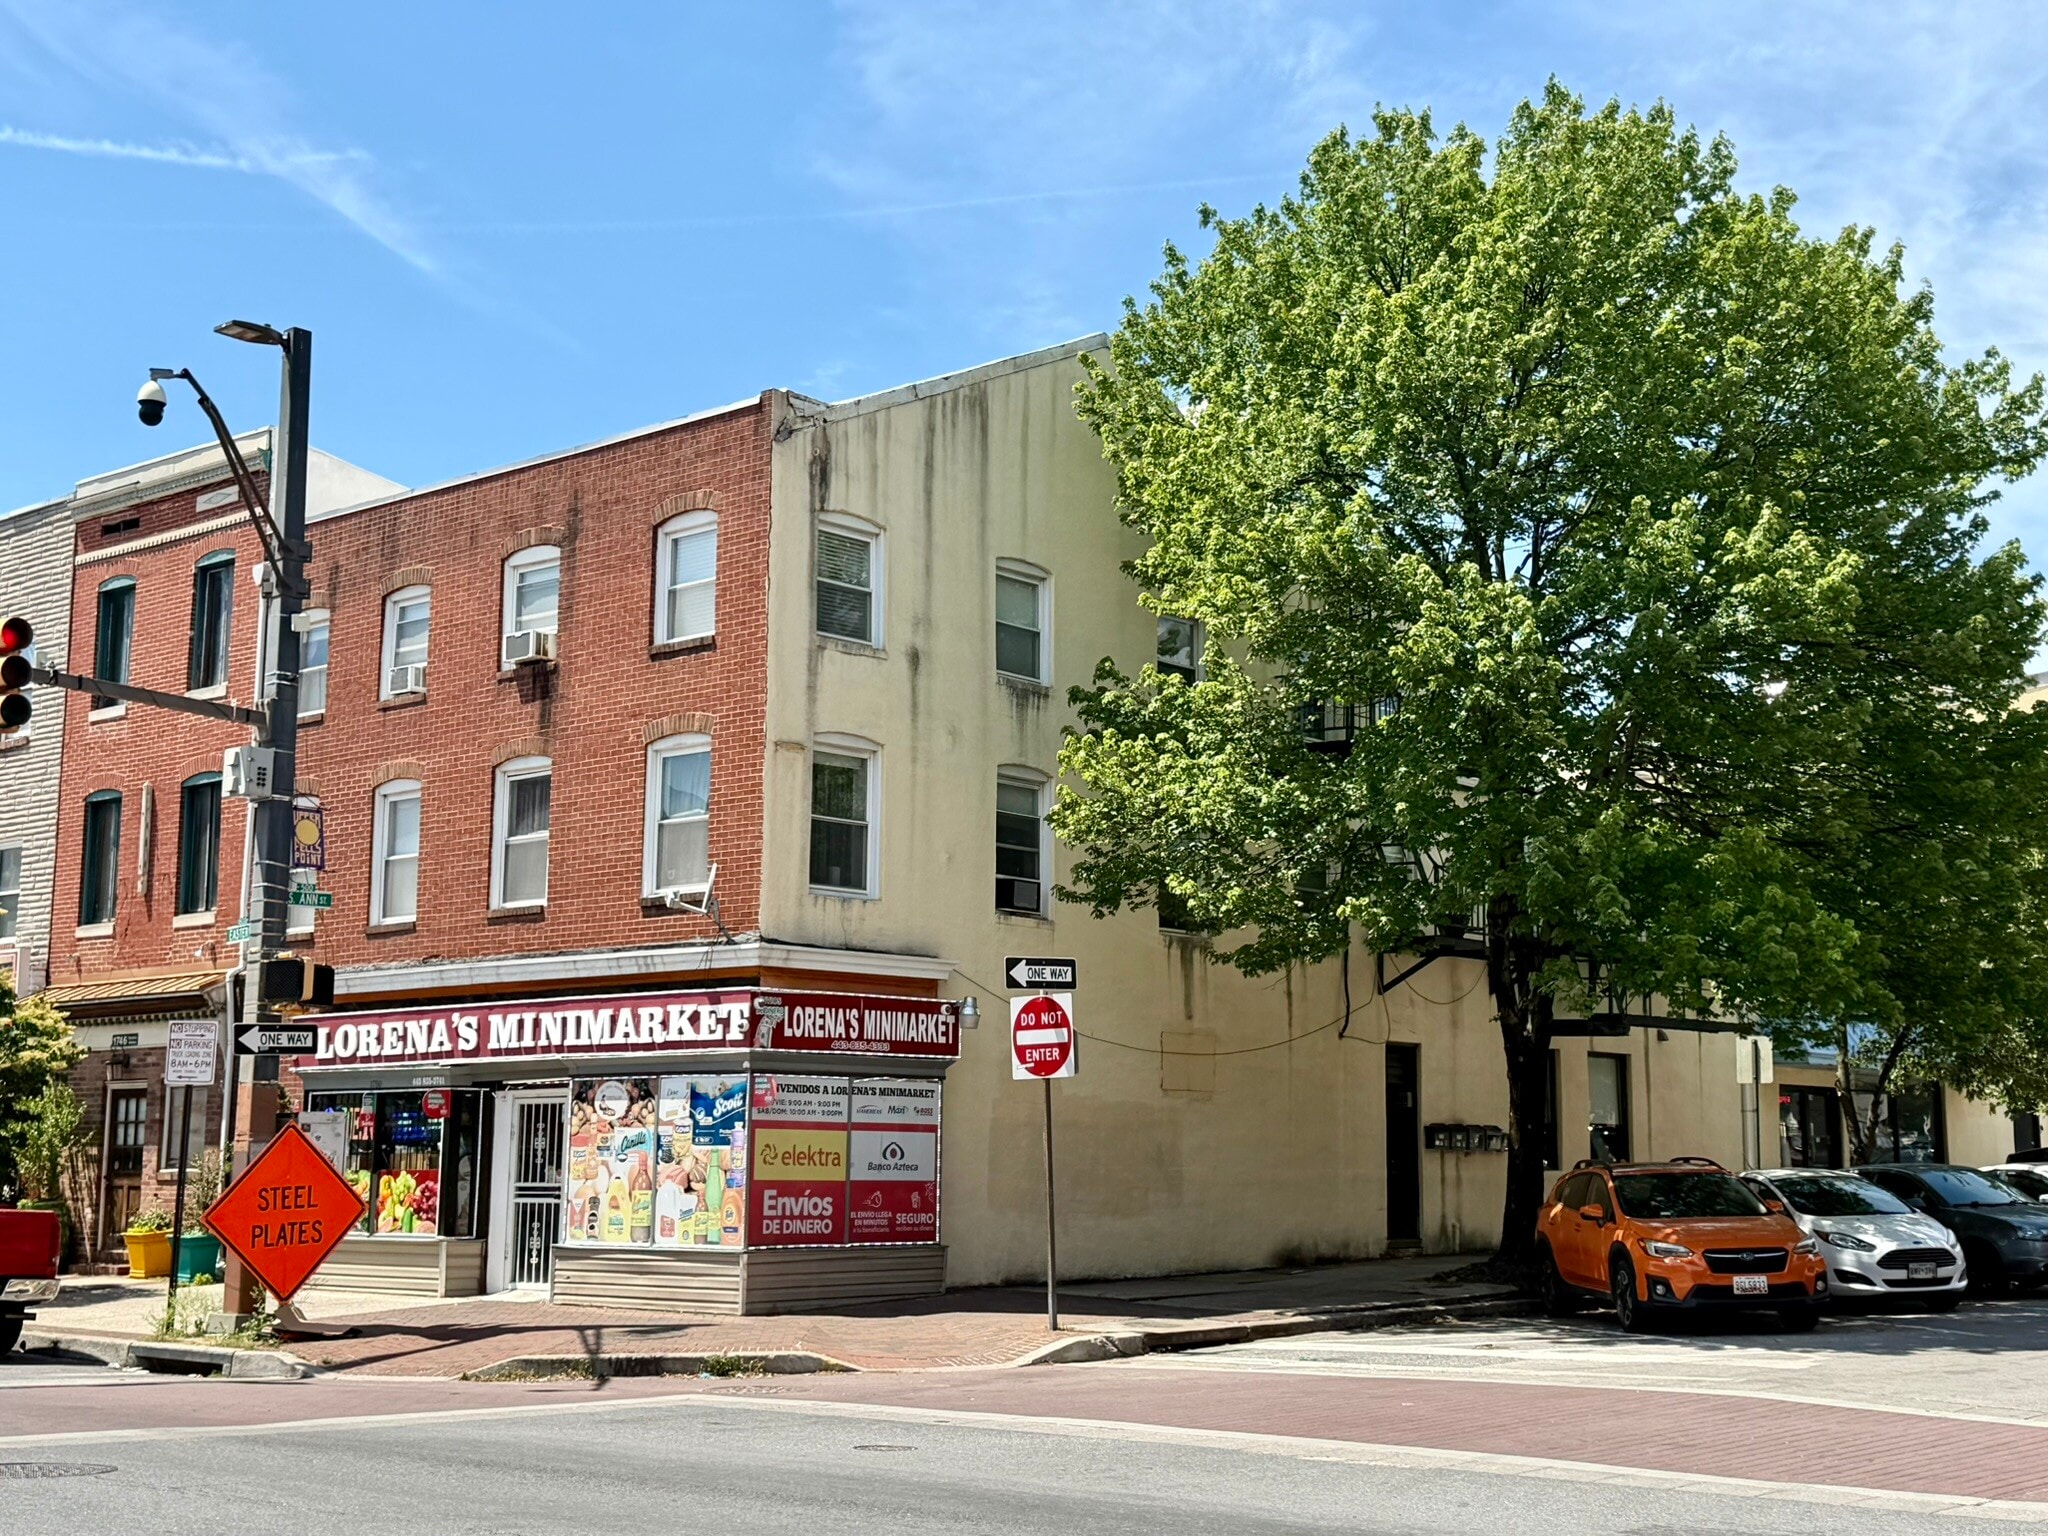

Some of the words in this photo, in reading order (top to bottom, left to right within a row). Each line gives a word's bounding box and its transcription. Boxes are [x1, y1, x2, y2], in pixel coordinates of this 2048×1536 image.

[293, 811, 321, 828] UPPER
[299, 893, 319, 905] ANN
[1027, 967, 1047, 980] ONE
[1050, 967, 1069, 980] WAY
[784, 1005, 859, 1039] LORENA'S
[864, 1009, 956, 1044] MINIMARKET
[1021, 1012, 1036, 1026] DO
[1041, 1011, 1062, 1025] NOT
[171, 1024, 183, 1033] NO
[315, 1012, 478, 1060] LORENA'S
[487, 1002, 751, 1050] MINIMARKET
[170, 1040, 182, 1049] NO
[184, 1040, 213, 1049] PARKING
[260, 1033, 283, 1045] ONE
[287, 1033, 309, 1045] WAY
[1025, 1047, 1060, 1062] ENTER
[822, 1084, 829, 1095] A
[878, 1087, 936, 1098] MINIMARKET
[713, 1092, 744, 1118] Scott
[781, 1144, 841, 1167] elektra
[867, 1162, 892, 1172] Banco
[892, 1162, 919, 1172] Azteca
[257, 1185, 319, 1212] STEEL
[763, 1188, 834, 1217] Envíos
[850, 1211, 857, 1219] EL
[895, 1213, 934, 1224] SEGURO
[251, 1219, 323, 1250] PLATES
[762, 1219, 781, 1235] DE
[783, 1219, 833, 1235] DINERO
